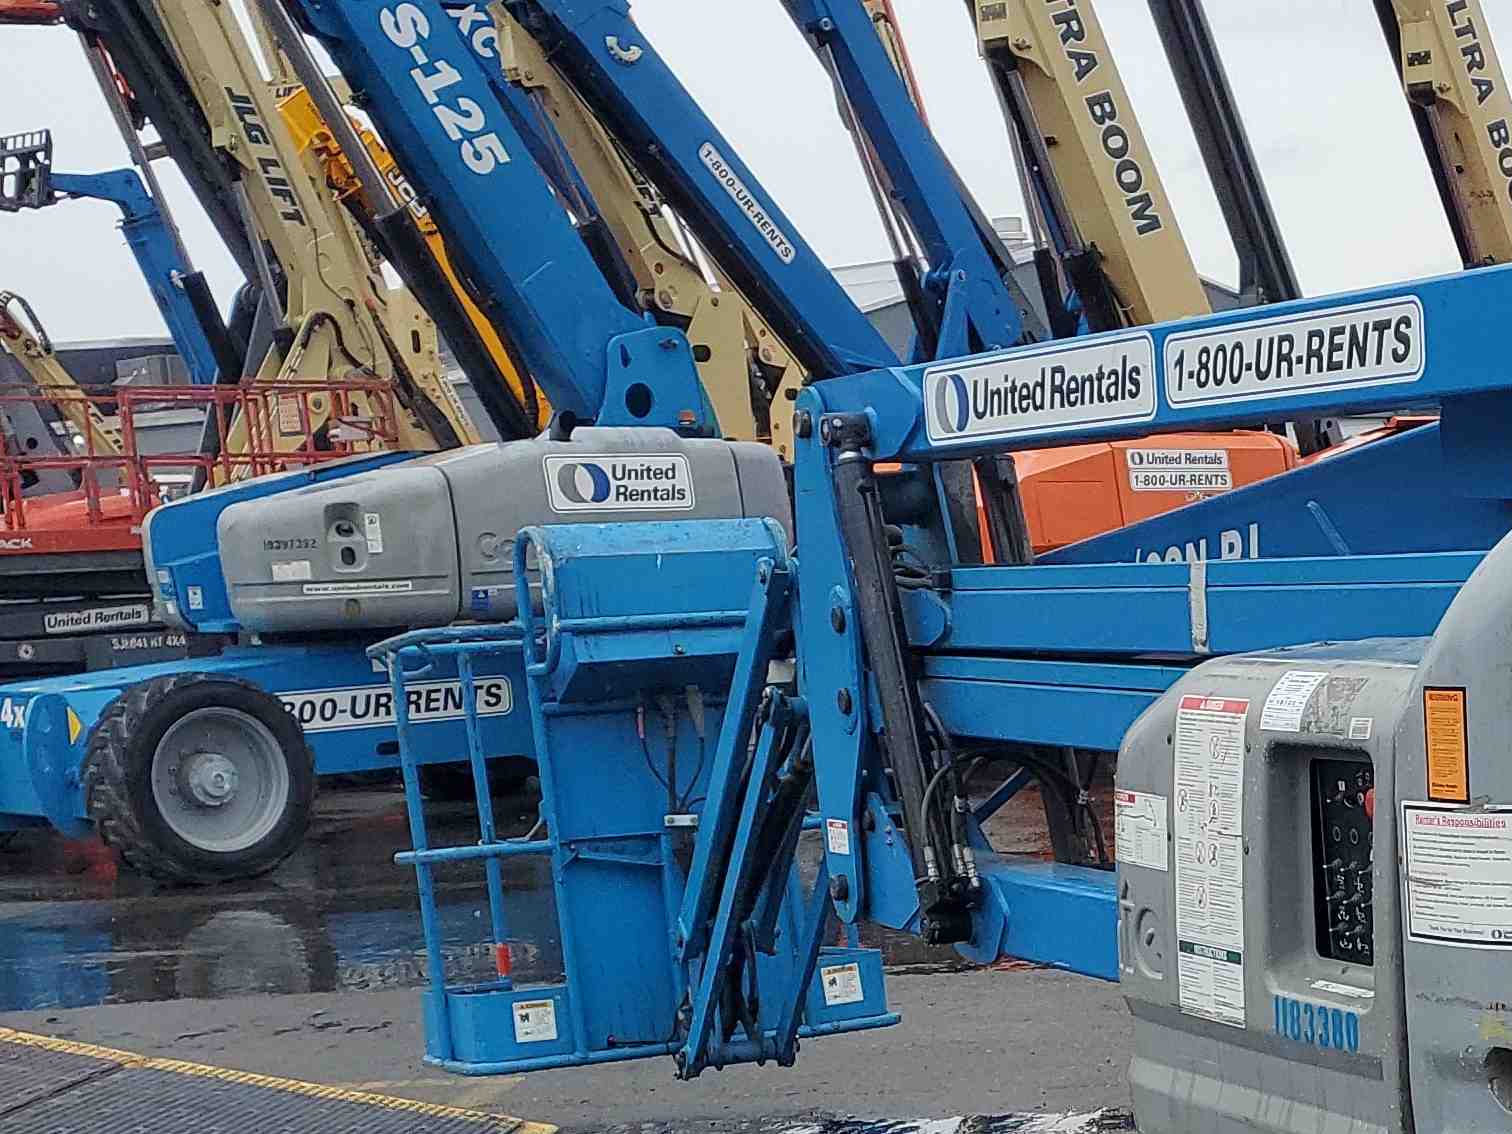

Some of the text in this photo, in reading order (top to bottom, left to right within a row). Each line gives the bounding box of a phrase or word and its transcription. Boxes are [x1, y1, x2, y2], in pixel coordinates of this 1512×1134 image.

[380, 3, 511, 174] S-125
[1045, 0, 1162, 235] RA BOOM
[224, 87, 306, 226] JLG LIFT
[702, 150, 793, 259] 1-800-UR-RENTS
[1173, 315, 1412, 392] 1-800-UR-RENTS
[972, 355, 1141, 420] United Rentals
[611, 463, 676, 482] United
[1134, 473, 1228, 486] 1-800-UR-RENTS
[1146, 452, 1223, 465] United Rentals
[615, 484, 687, 503] Rentals
[47, 612, 91, 629] United
[1441, 815, 1506, 829] Responsibilities
